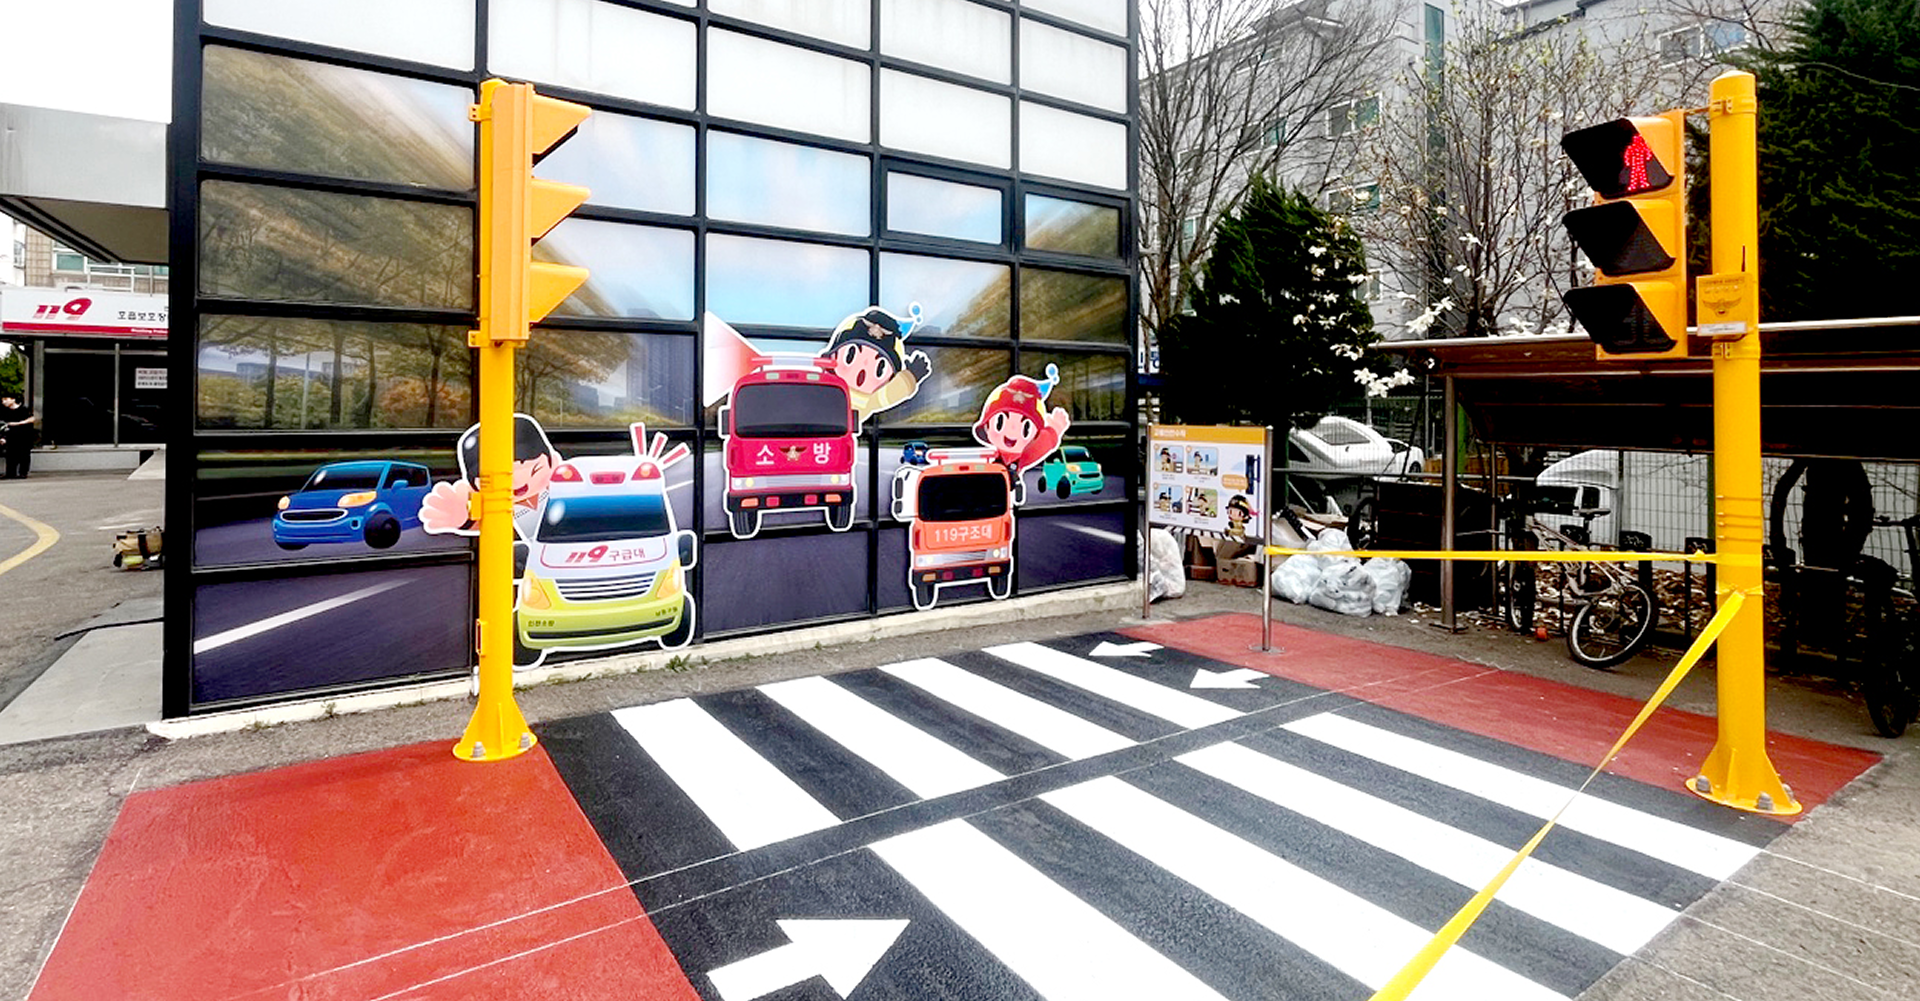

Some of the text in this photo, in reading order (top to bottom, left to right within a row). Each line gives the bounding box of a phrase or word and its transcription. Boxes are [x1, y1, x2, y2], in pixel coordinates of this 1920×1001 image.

[33, 298, 93, 320] 119
[934, 524, 992, 543] 119구조대
[565, 545, 646, 563] 119 구급대
